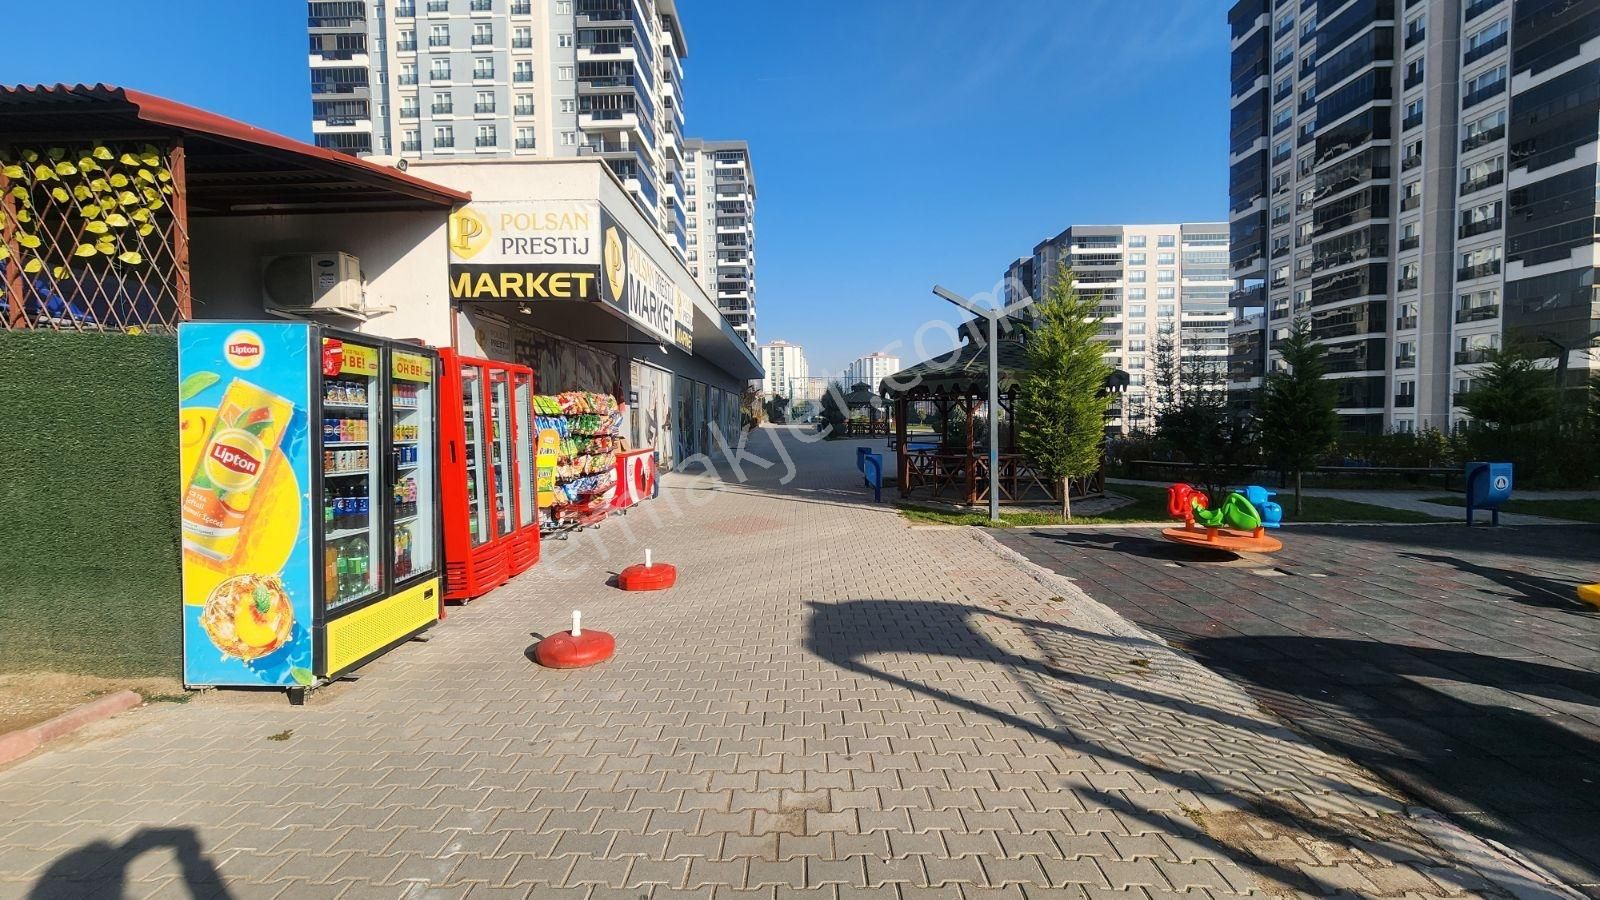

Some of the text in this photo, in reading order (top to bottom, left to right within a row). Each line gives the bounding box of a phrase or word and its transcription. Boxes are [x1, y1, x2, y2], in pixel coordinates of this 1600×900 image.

[501, 213, 589, 231] POLSAN
[450, 272, 594, 298] MARKET
[629, 272, 674, 337] MARKET
[231, 345, 258, 355] Lipton
[349, 356, 365, 369] BE!
[397, 362, 409, 374] OH
[410, 364, 423, 376] BE!
[214, 445, 256, 473] Lipton
